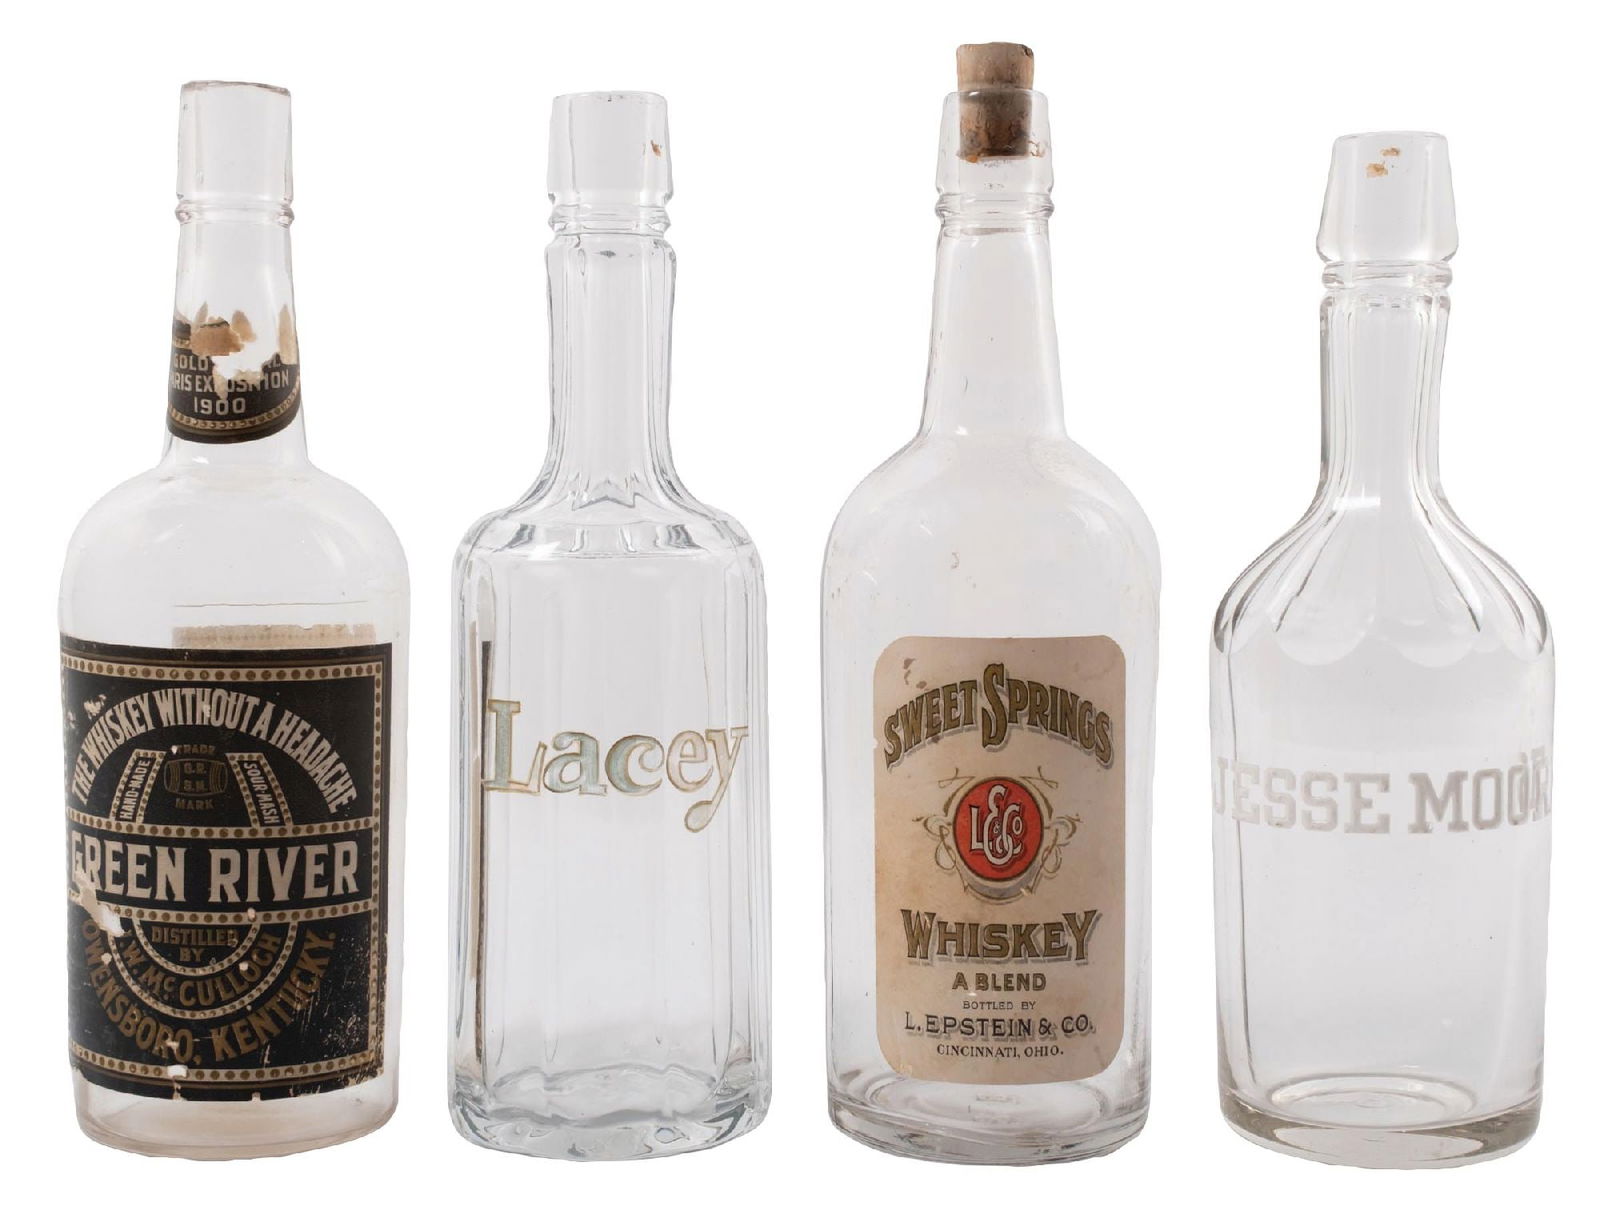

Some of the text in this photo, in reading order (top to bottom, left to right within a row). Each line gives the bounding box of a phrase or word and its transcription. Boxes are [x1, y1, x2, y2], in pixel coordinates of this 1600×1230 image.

[173, 353, 209, 371] GOLD
[195, 368, 289, 393] EXOSION
[193, 396, 246, 416] 1900
[884, 662, 1115, 770] SWEET SPRINGS
[72, 687, 357, 814] THE WHISKEY WITHOUT A HEADACHE
[481, 698, 749, 833] Lacey
[175, 797, 215, 810] MARK
[1212, 756, 1390, 834] JESSE
[71, 830, 360, 903] GREEN RIVER
[900, 908, 1101, 964] WHISKEY
[179, 947, 205, 961] BY
[952, 971, 1047, 992] A BLEND
[963, 1001, 1037, 1010] BOTTLED BY
[1039, 1019, 1052, 1036] &
[1061, 1013, 1095, 1034] CO.
[936, 1043, 1065, 1059] CINCINNATI, OHIO.
